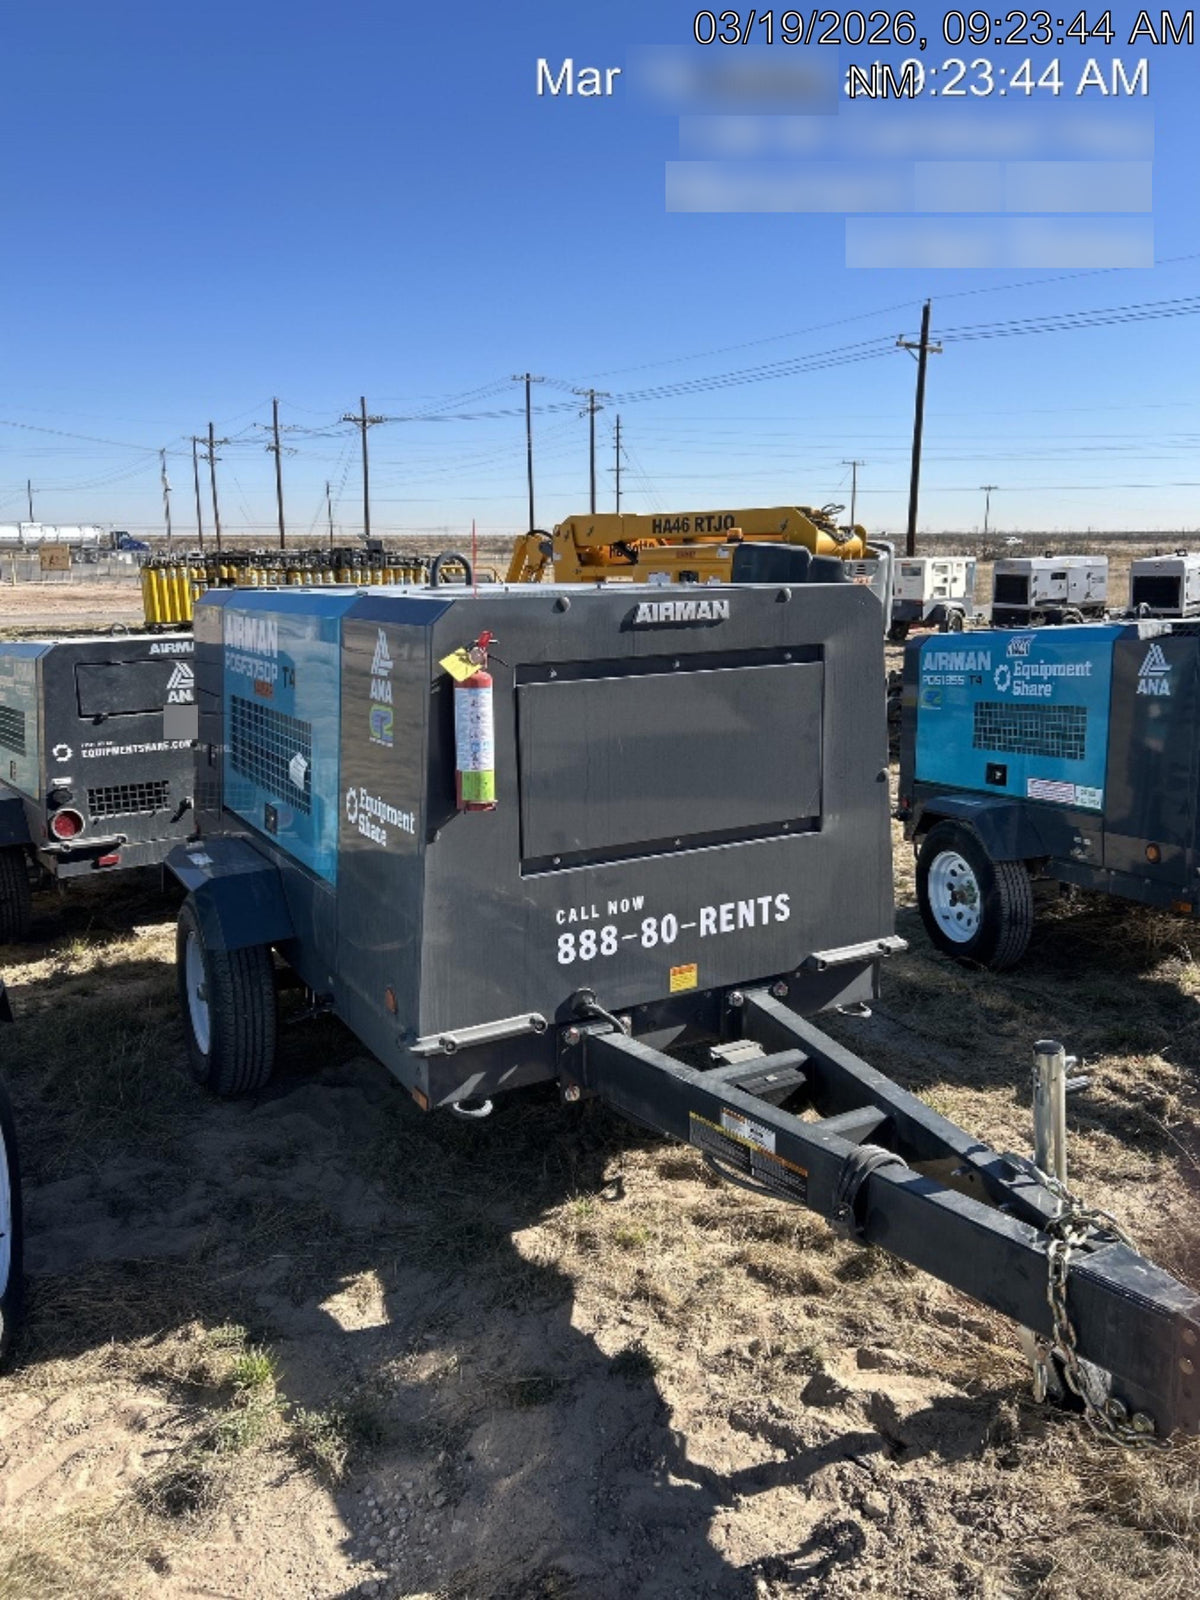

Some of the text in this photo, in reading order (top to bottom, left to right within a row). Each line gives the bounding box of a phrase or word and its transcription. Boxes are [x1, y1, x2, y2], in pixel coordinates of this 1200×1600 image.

[652, 518, 690, 534] HA46
[635, 600, 729, 623] AIRMAN
[224, 614, 278, 658] AIRMAN
[922, 651, 992, 671] AIRMAN
[1013, 660, 1093, 680] Equipment
[167, 690, 194, 703] AN
[370, 679, 393, 704] ANA
[1013, 680, 1053, 696] Share
[1136, 679, 1170, 695] ANA
[359, 787, 415, 834] Equipment
[358, 813, 387, 847] Share
[556, 896, 645, 925] CALL NOW
[557, 893, 791, 964] 888-80-RENTS
